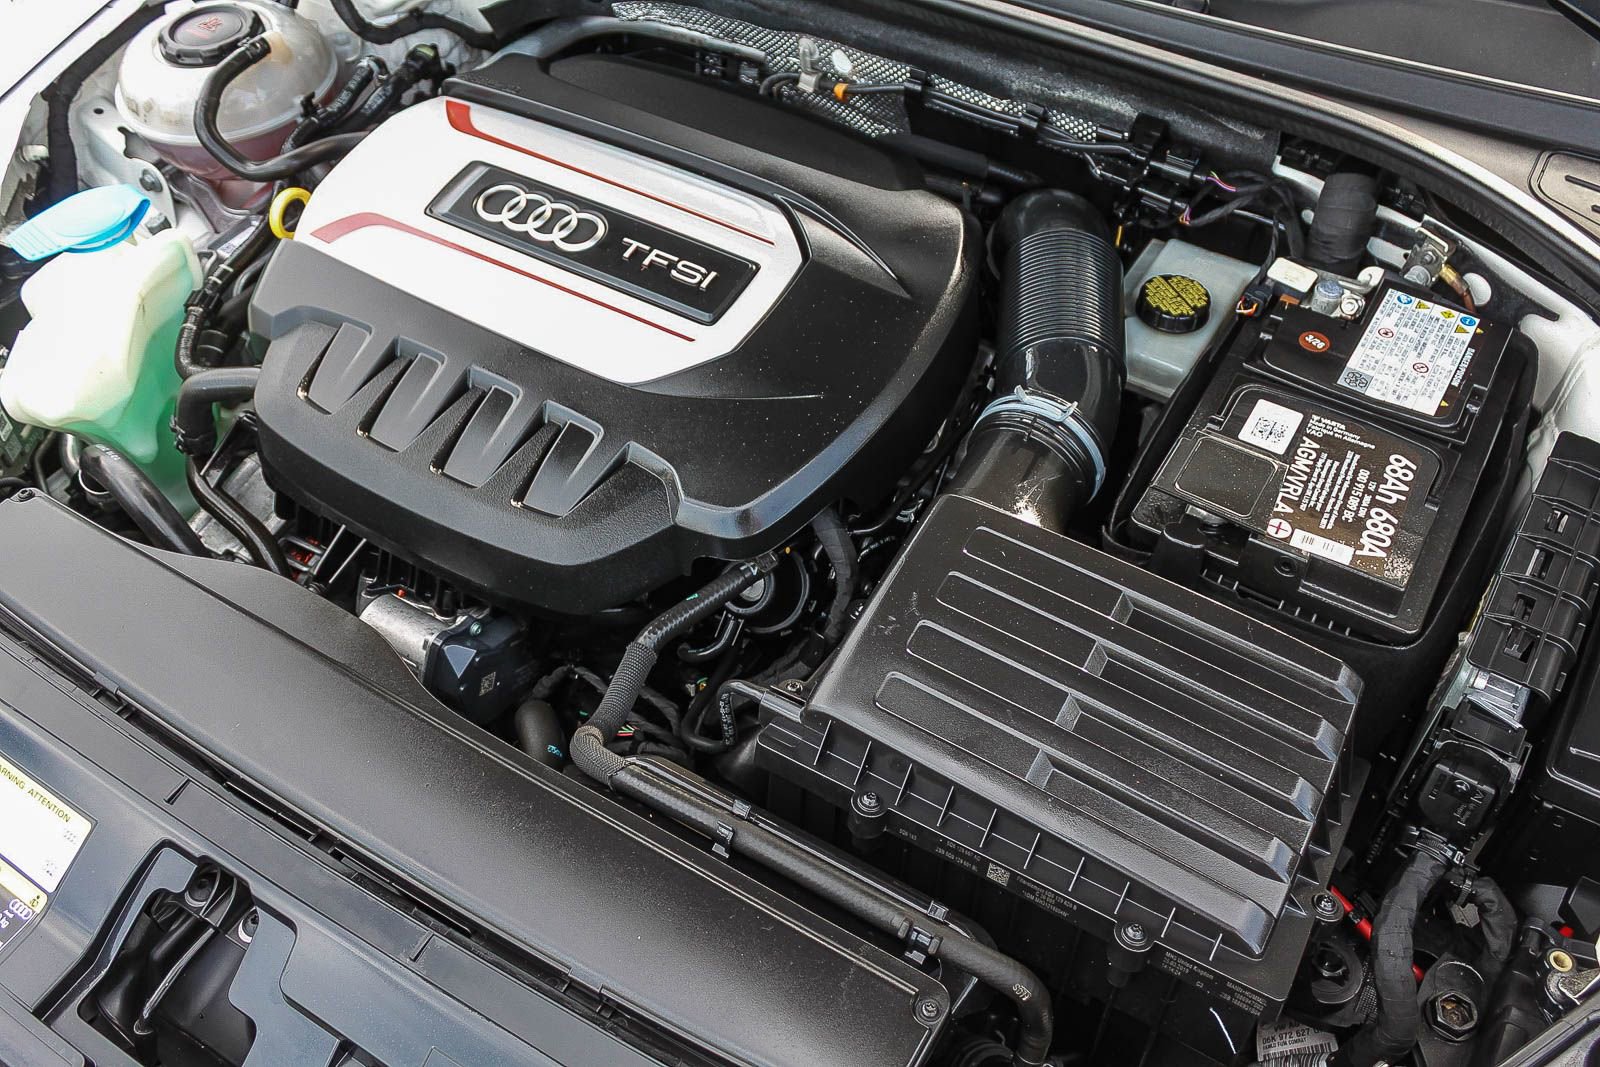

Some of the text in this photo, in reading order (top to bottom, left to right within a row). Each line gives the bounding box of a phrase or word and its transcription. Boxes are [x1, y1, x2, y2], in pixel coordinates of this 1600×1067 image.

[621, 237, 719, 292] TFSI
[1333, 427, 1360, 439] Germany
[1272, 436, 1320, 514] AGM/VRLA
[1357, 469, 1370, 482] 000
[1351, 483, 1365, 496] 915
[1355, 454, 1417, 558] 68Ah 680A
[1341, 510, 1355, 522] BC
[28, 788, 71, 823] ATTENTION
[1263, 1035, 1276, 1044] 06K
[1278, 1031, 1293, 1040] 972
[1295, 1028, 1310, 1037] 627
